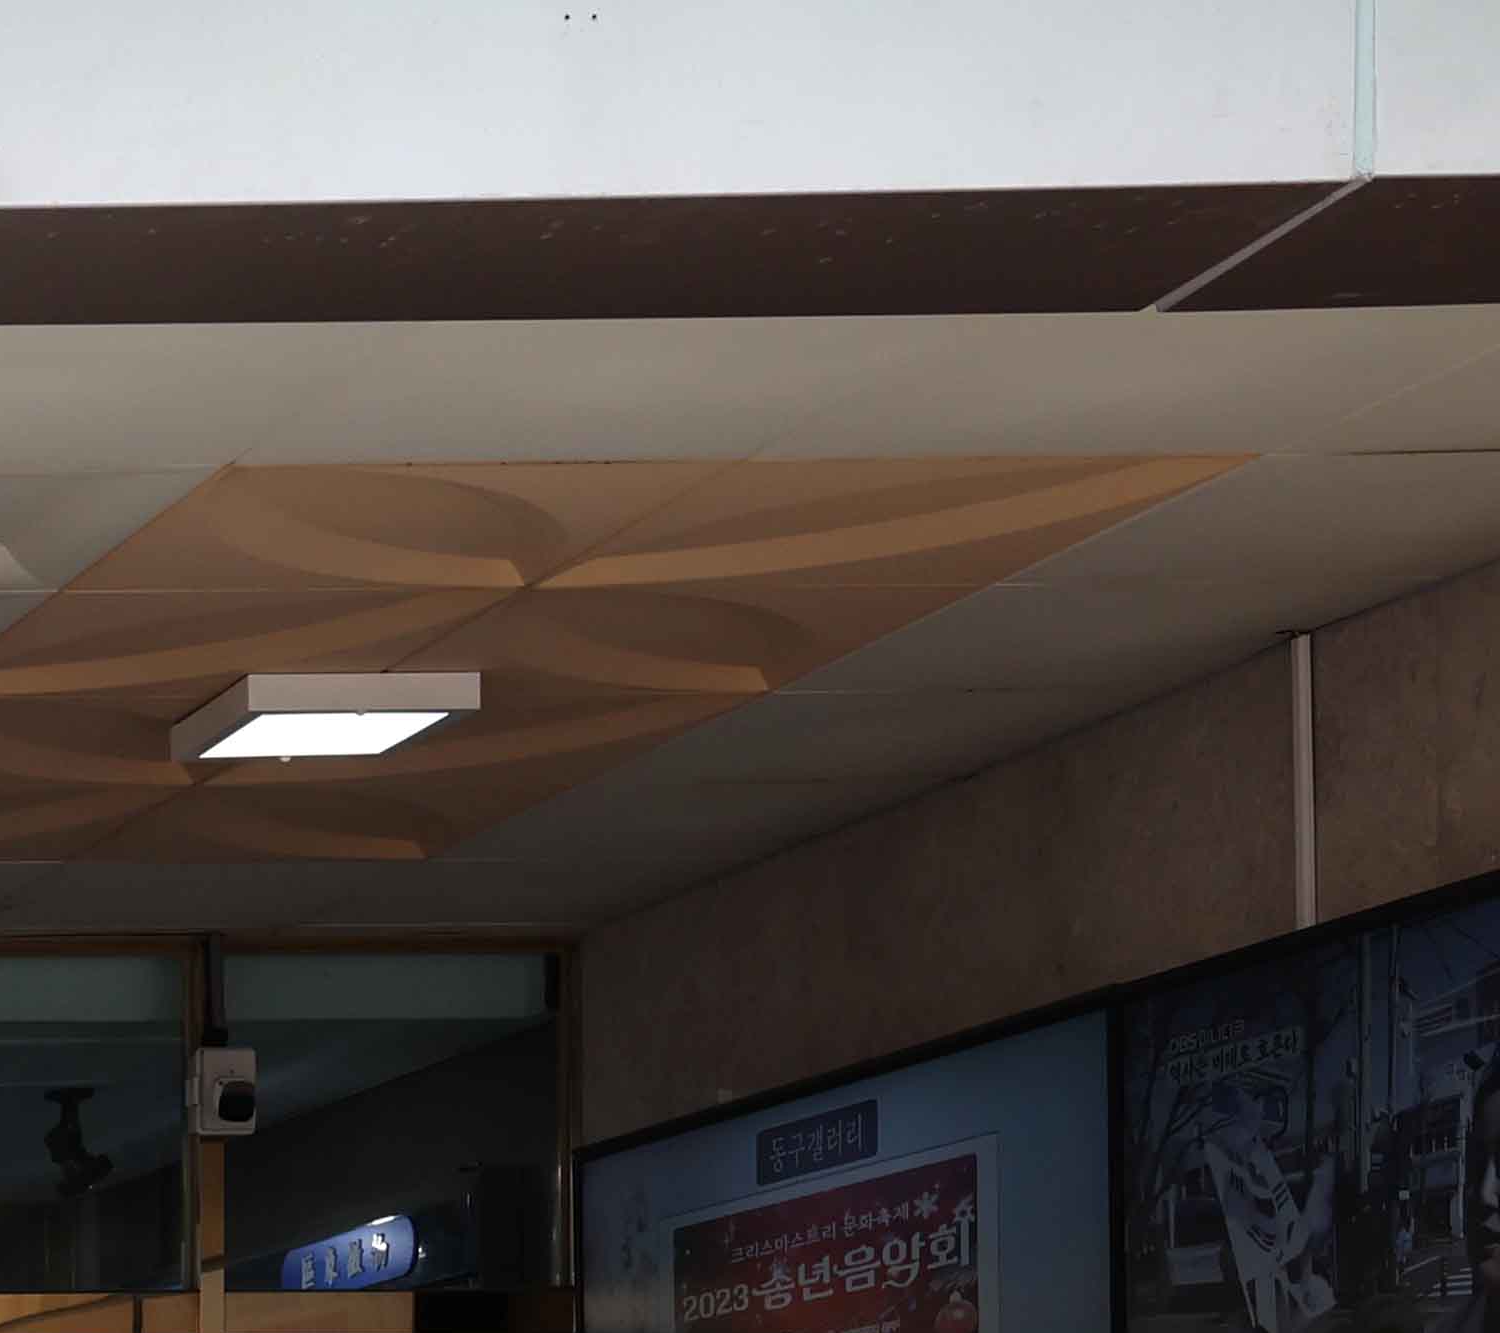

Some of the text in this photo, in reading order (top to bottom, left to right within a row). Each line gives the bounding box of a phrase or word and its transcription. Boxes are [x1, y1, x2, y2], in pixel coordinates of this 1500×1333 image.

[771, 1112, 864, 1173] 동구갤러리
[731, 1202, 909, 1264] 크리스마스트리 문화축제
